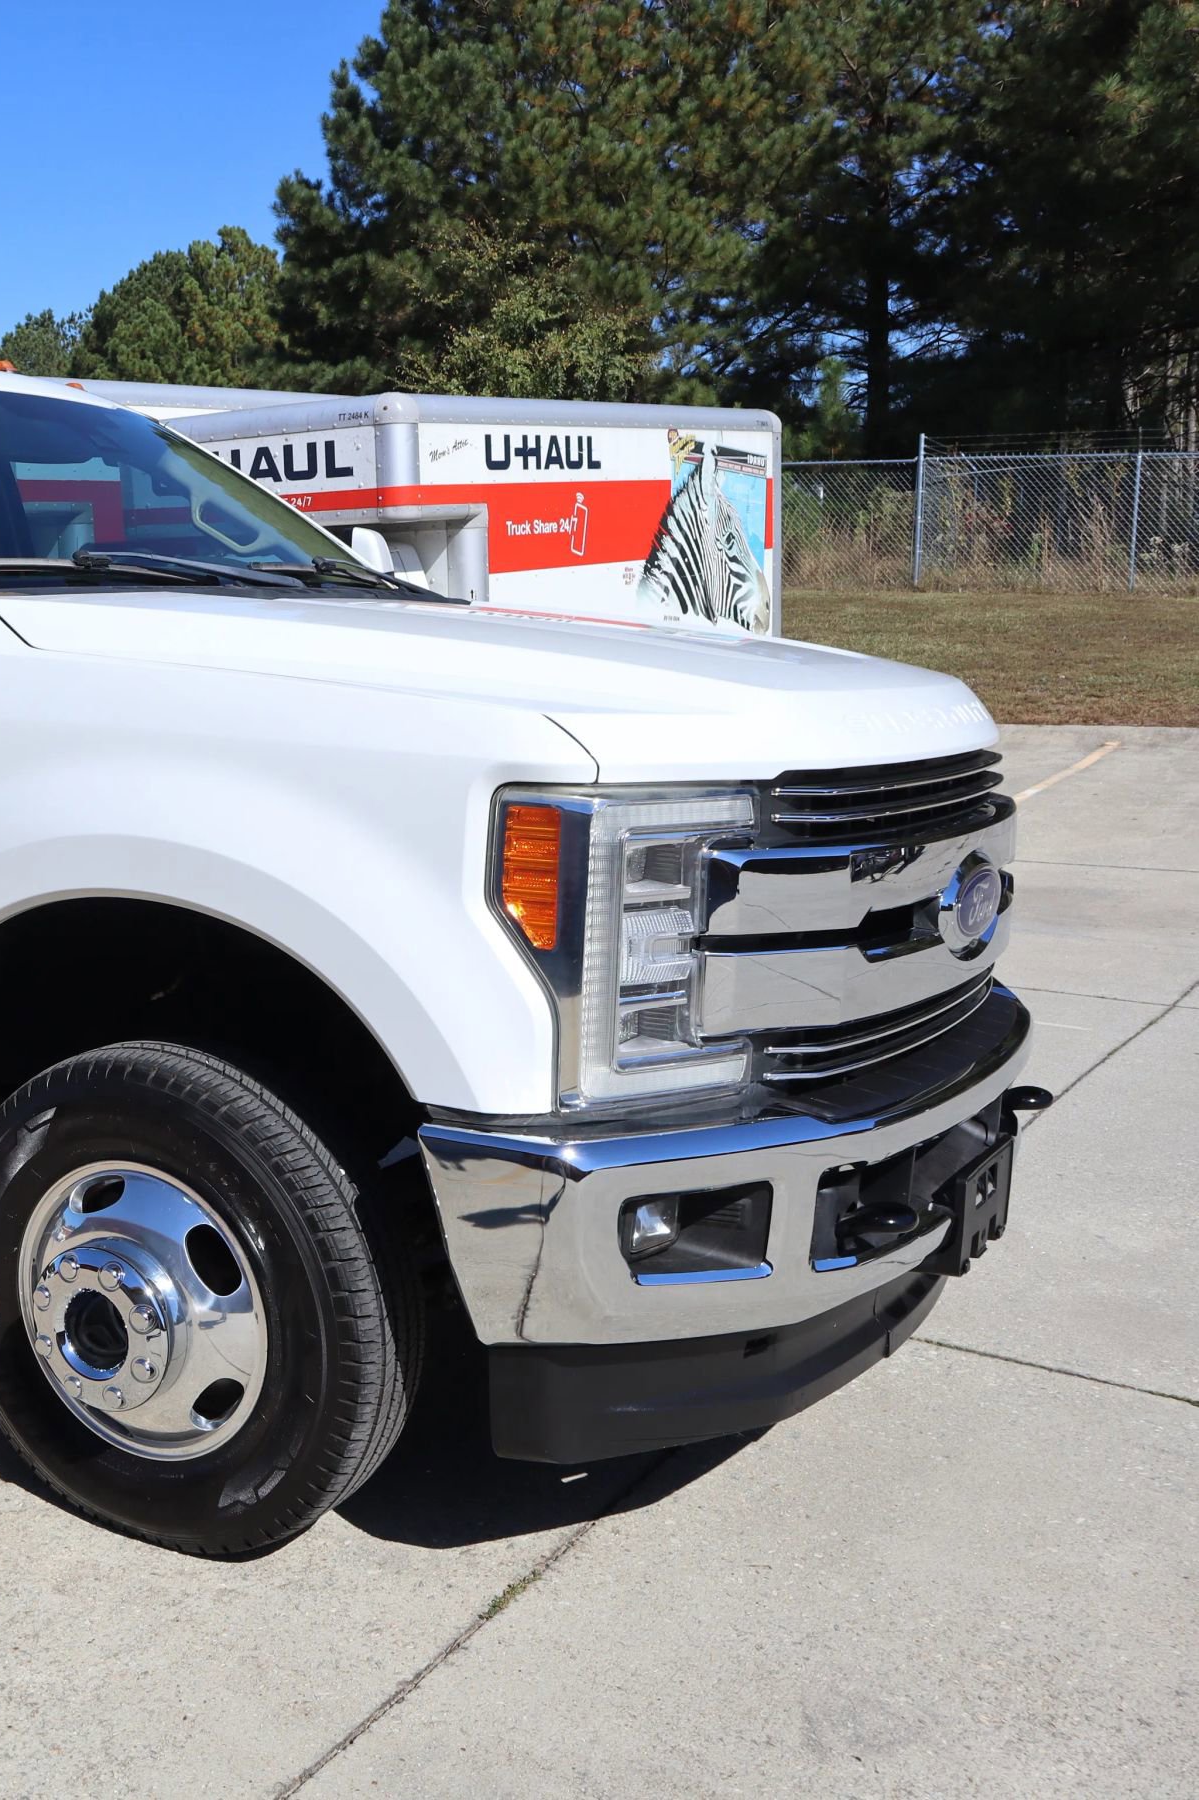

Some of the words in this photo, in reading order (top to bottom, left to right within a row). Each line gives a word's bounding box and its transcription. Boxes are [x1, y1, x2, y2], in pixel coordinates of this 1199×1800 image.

[484, 434, 601, 470] U-HAUL
[290, 496, 312, 508] 24/7
[506, 520, 531, 536] Truck
[533, 519, 558, 534] Share
[559, 514, 578, 535] 24/7
[968, 882, 996, 926] Ford
